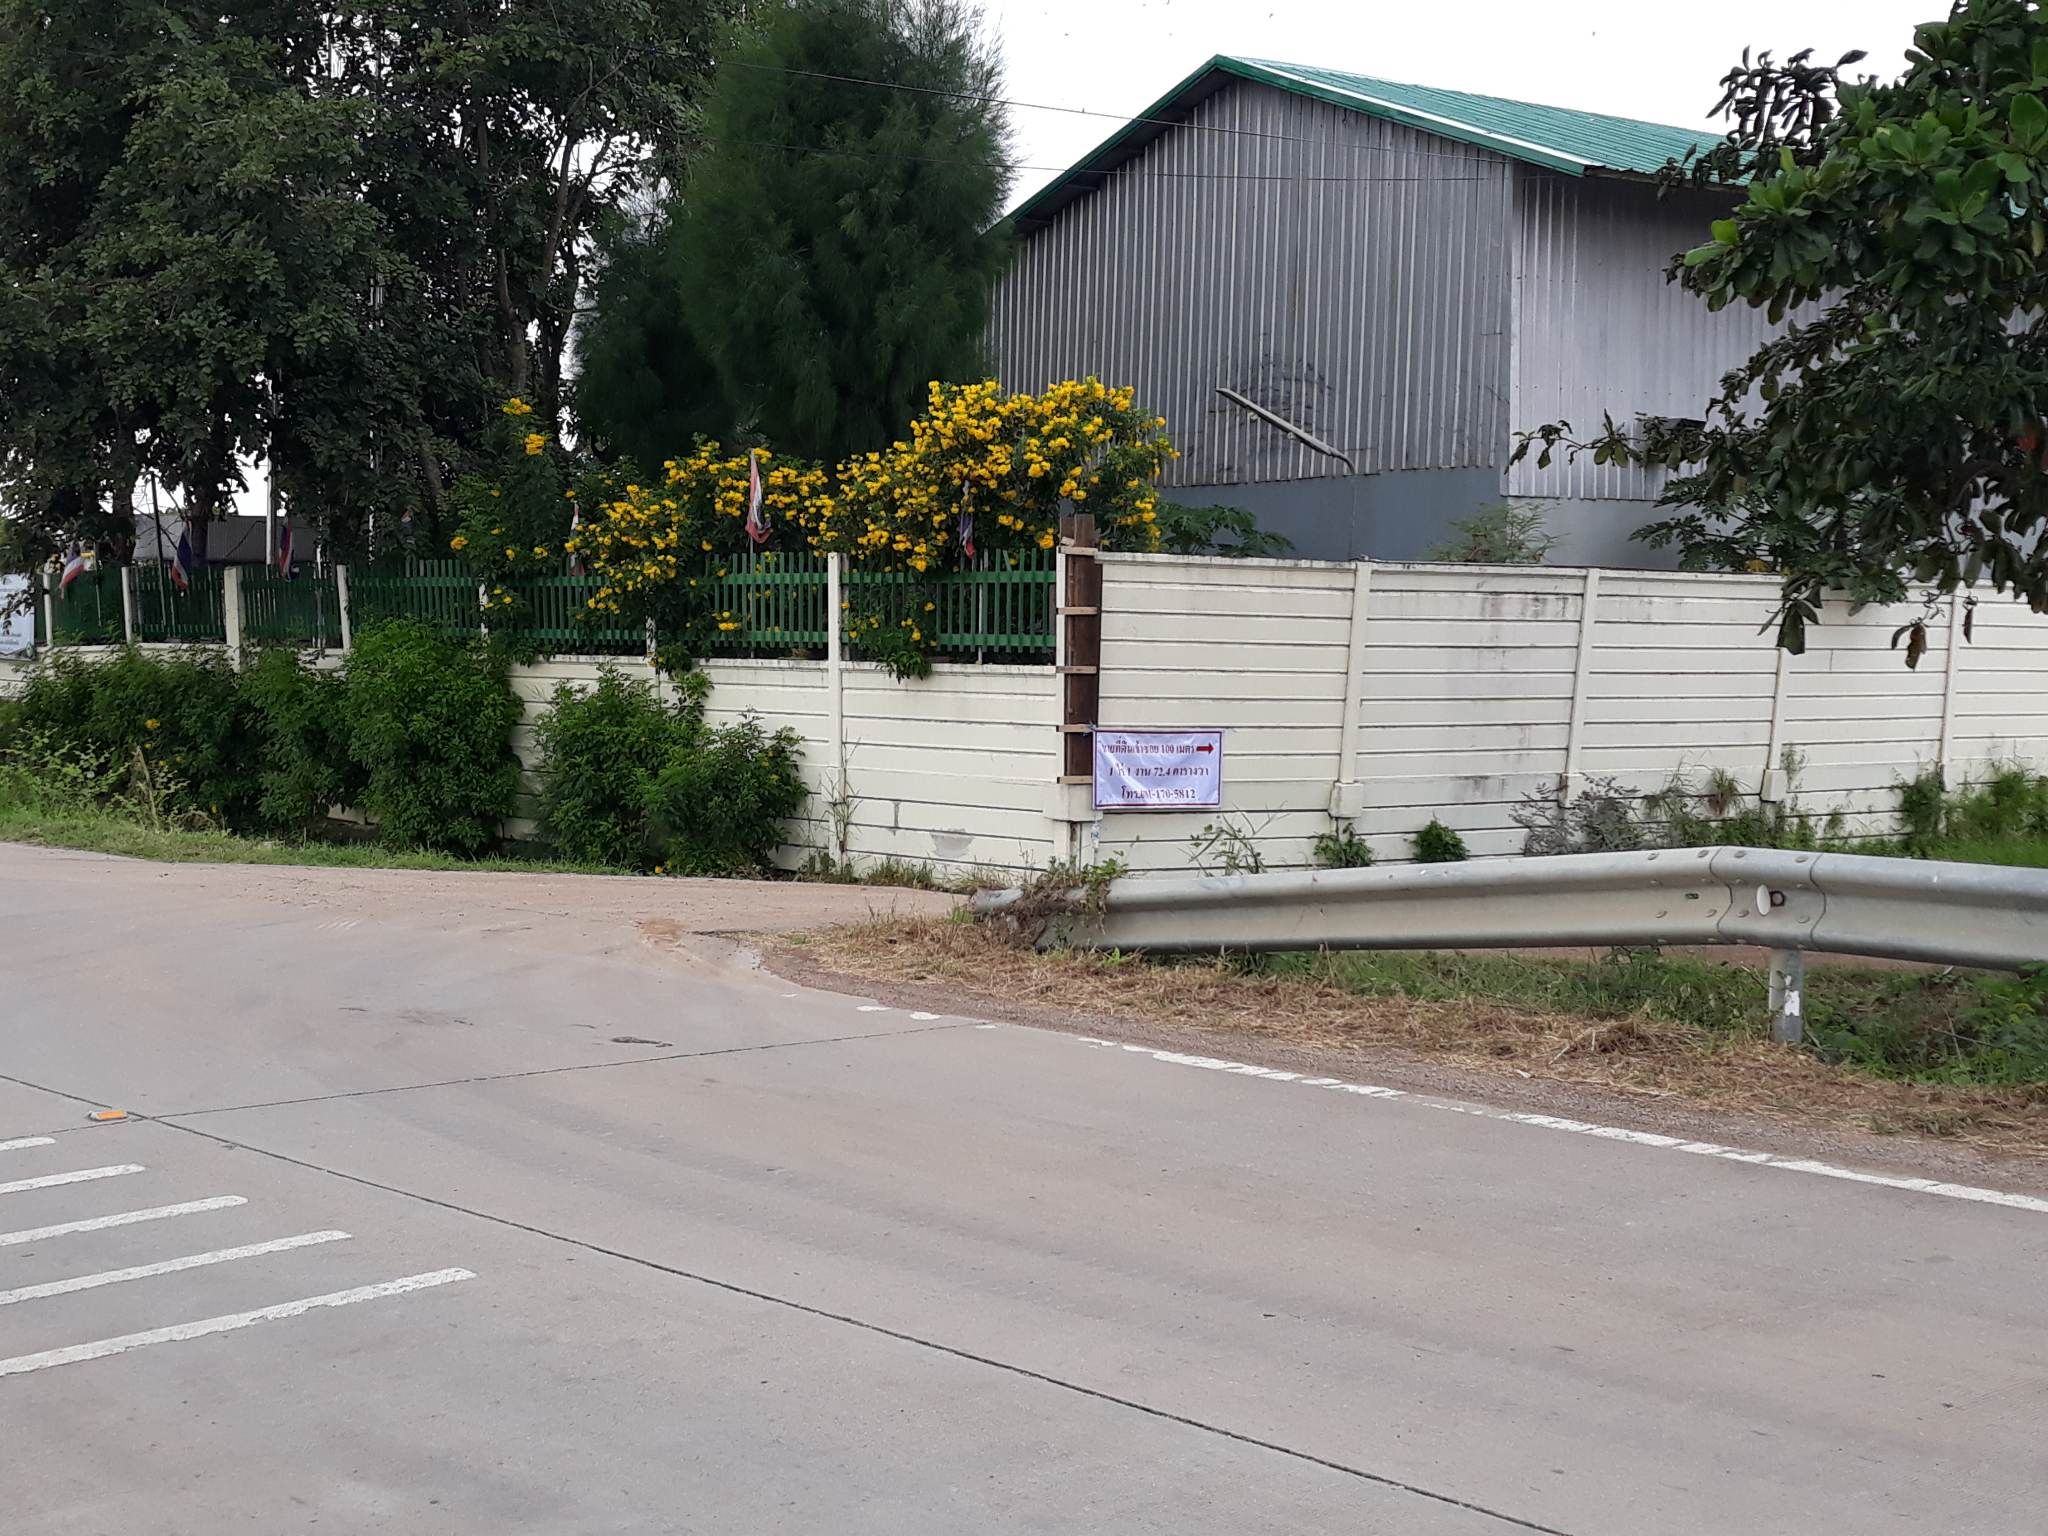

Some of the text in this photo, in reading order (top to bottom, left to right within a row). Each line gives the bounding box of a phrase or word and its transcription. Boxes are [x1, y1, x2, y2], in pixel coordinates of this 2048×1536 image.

[1161, 744, 1175, 754] 100
[1176, 744, 1195, 754] เมตร
[1135, 767, 1152, 777] งาน
[1153, 766, 1171, 777] 72.4
[1172, 767, 1209, 776] ตารางวา
